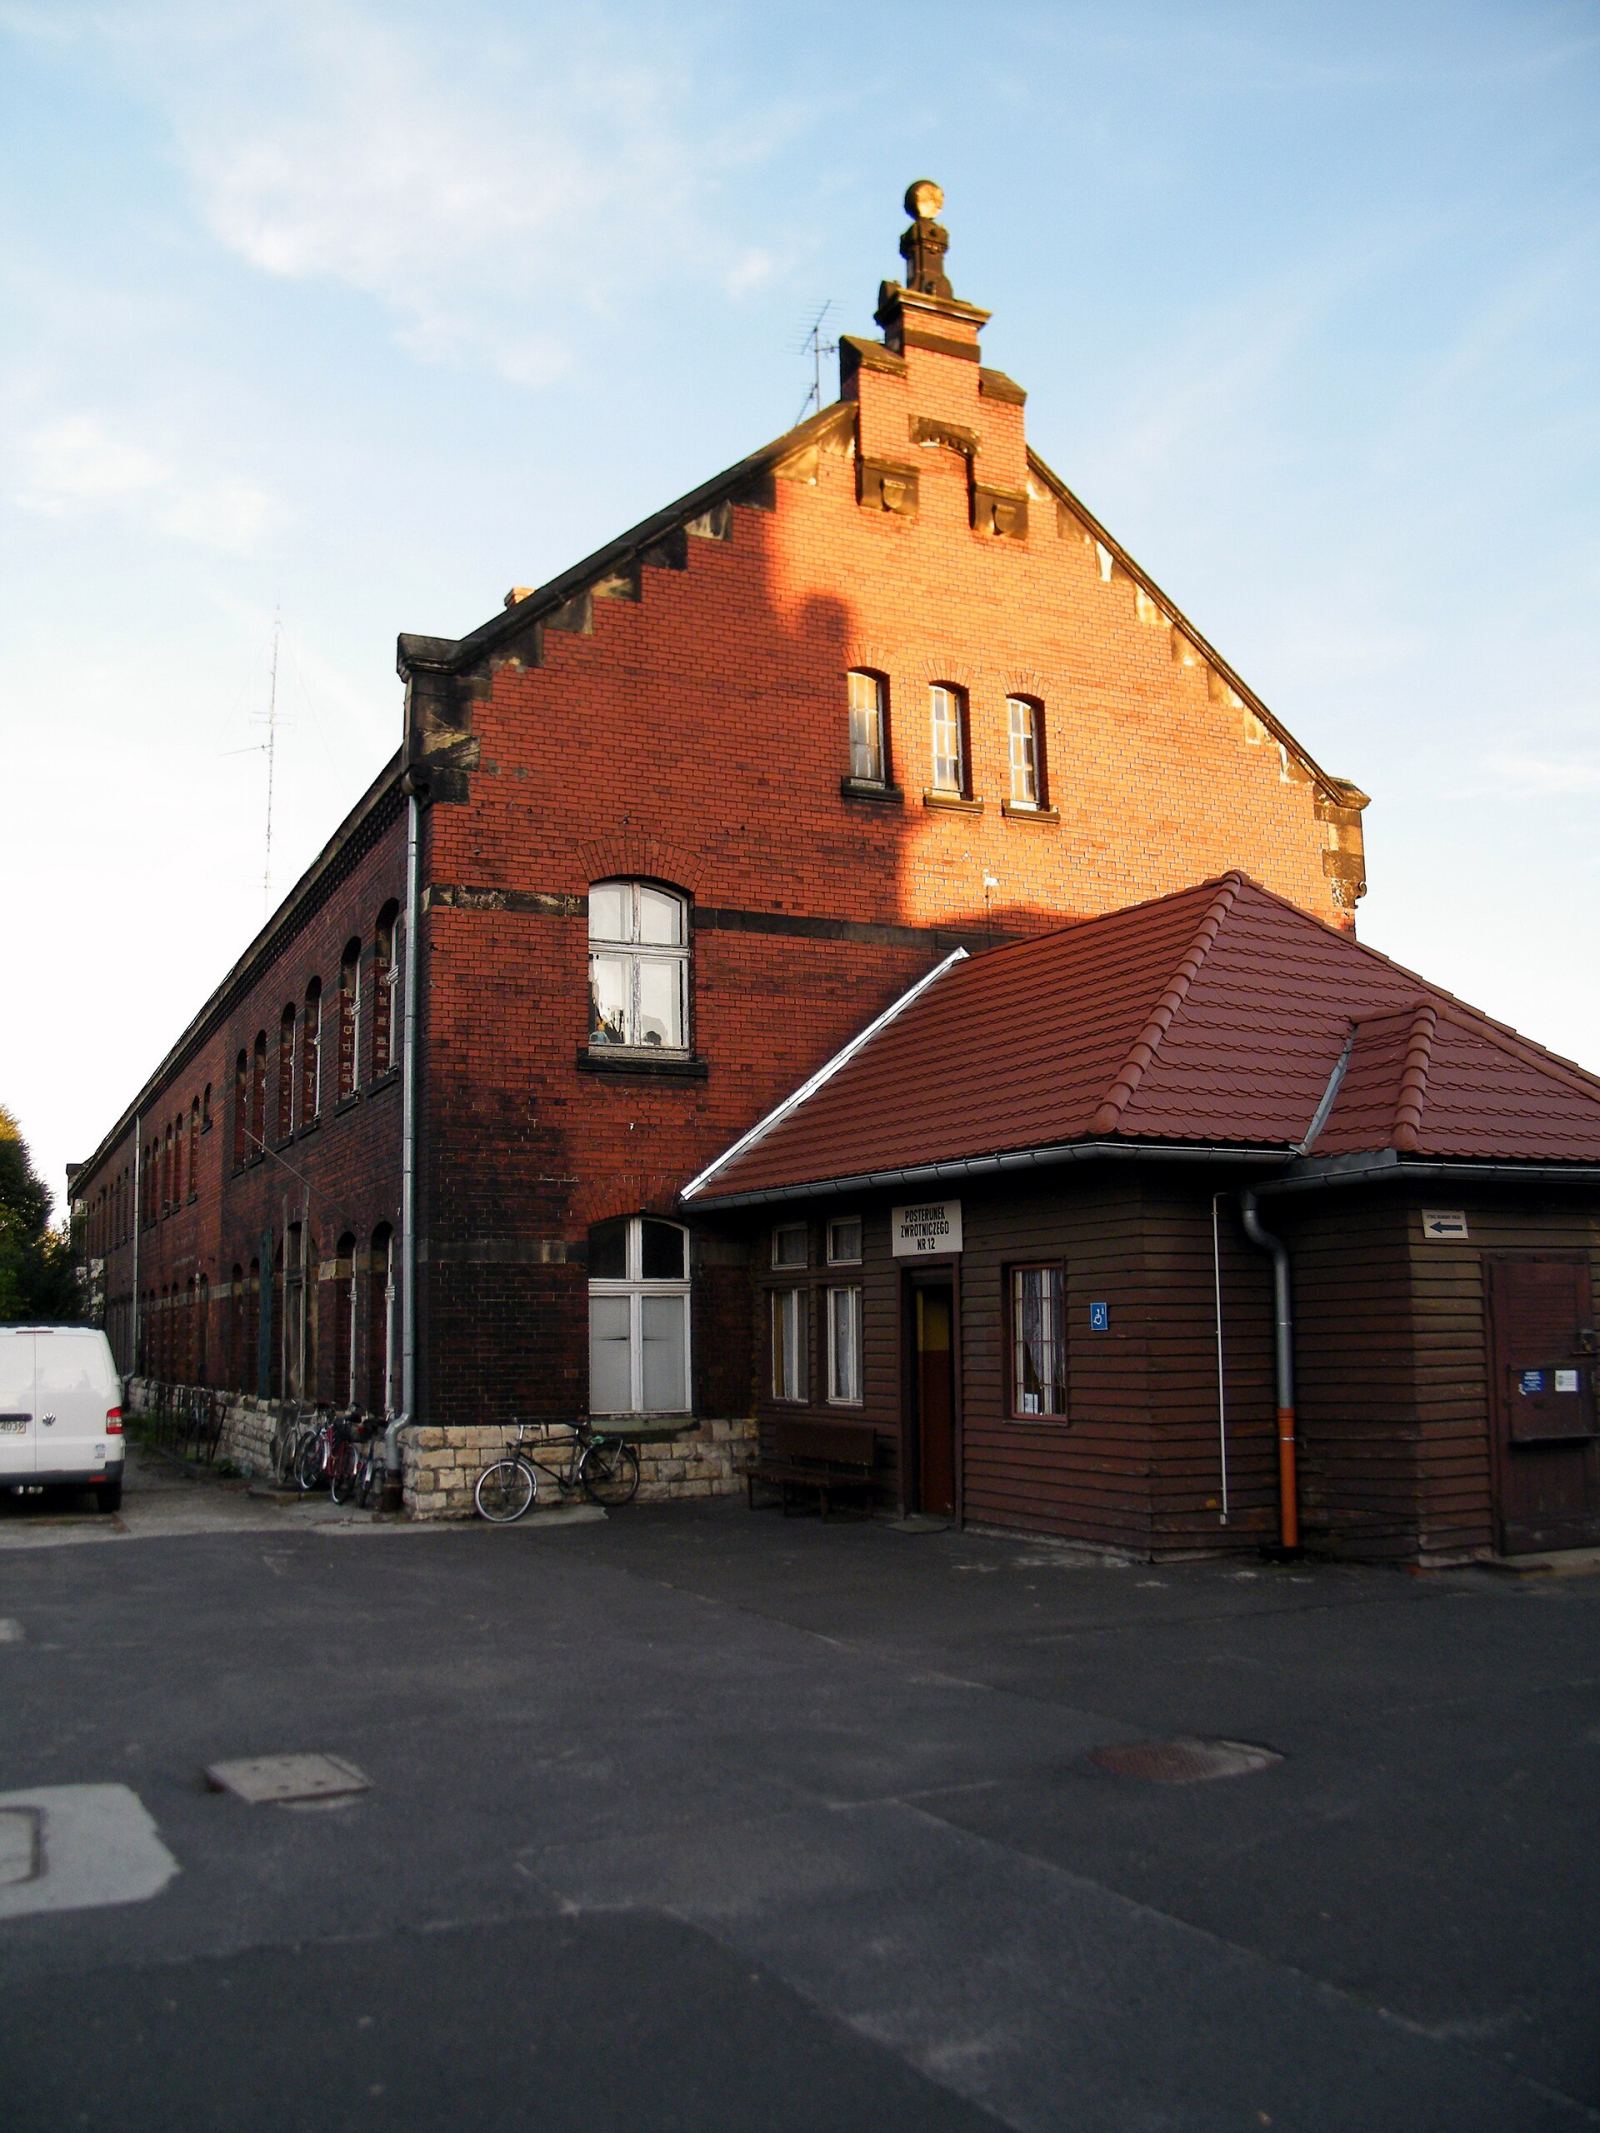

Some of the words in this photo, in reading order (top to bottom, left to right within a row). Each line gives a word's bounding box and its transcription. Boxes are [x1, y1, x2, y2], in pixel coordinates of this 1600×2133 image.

[905, 1207, 945, 1222] POSTERUNEK
[901, 1221, 949, 1238] ZWROTNICZEGO
[917, 1239, 926, 1250] NR
[928, 1238, 936, 1249] 12
